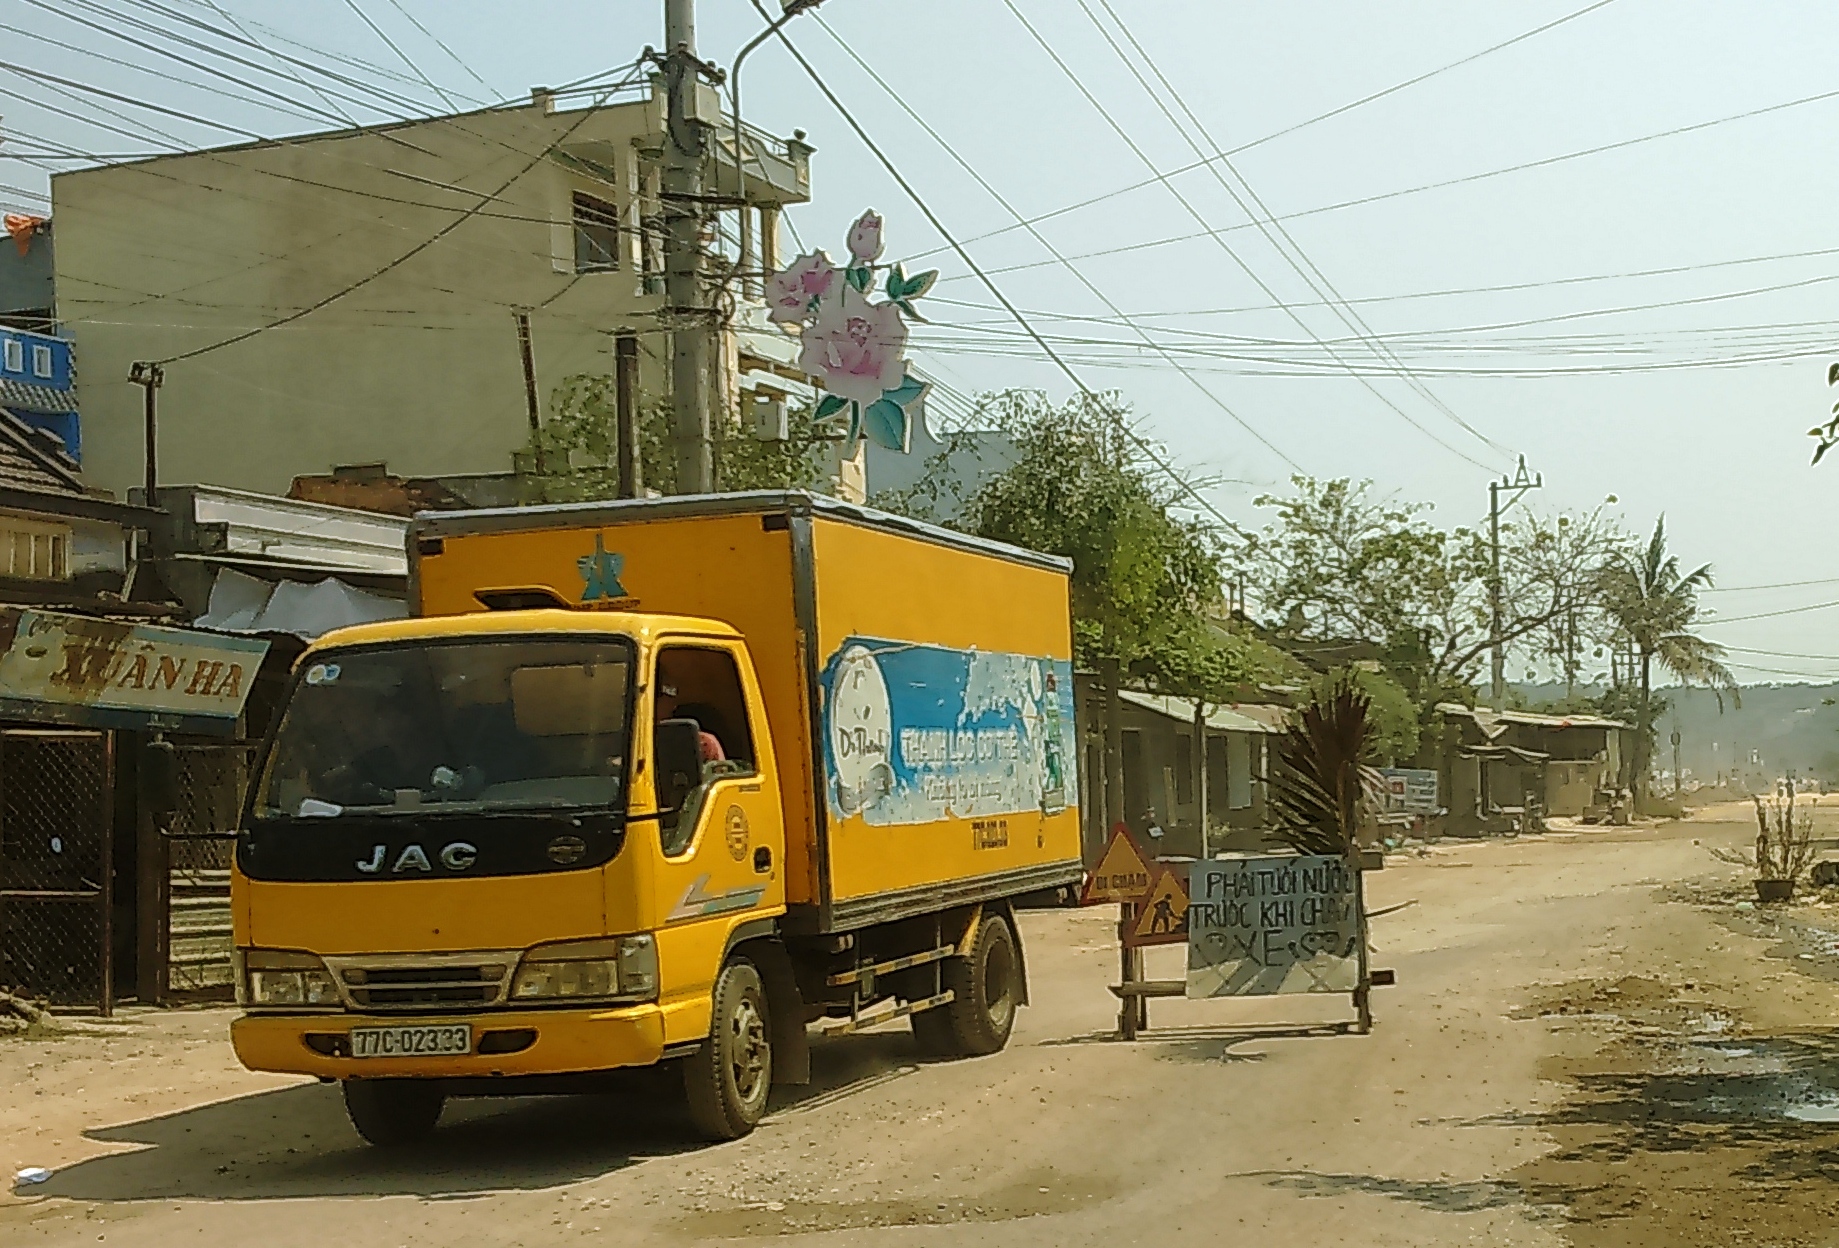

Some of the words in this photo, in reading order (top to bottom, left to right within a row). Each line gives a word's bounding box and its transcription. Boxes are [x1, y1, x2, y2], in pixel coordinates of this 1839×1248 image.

[355, 839, 479, 874] JAC
[1259, 900, 1295, 928] KHI
[1233, 929, 1285, 967] XE
